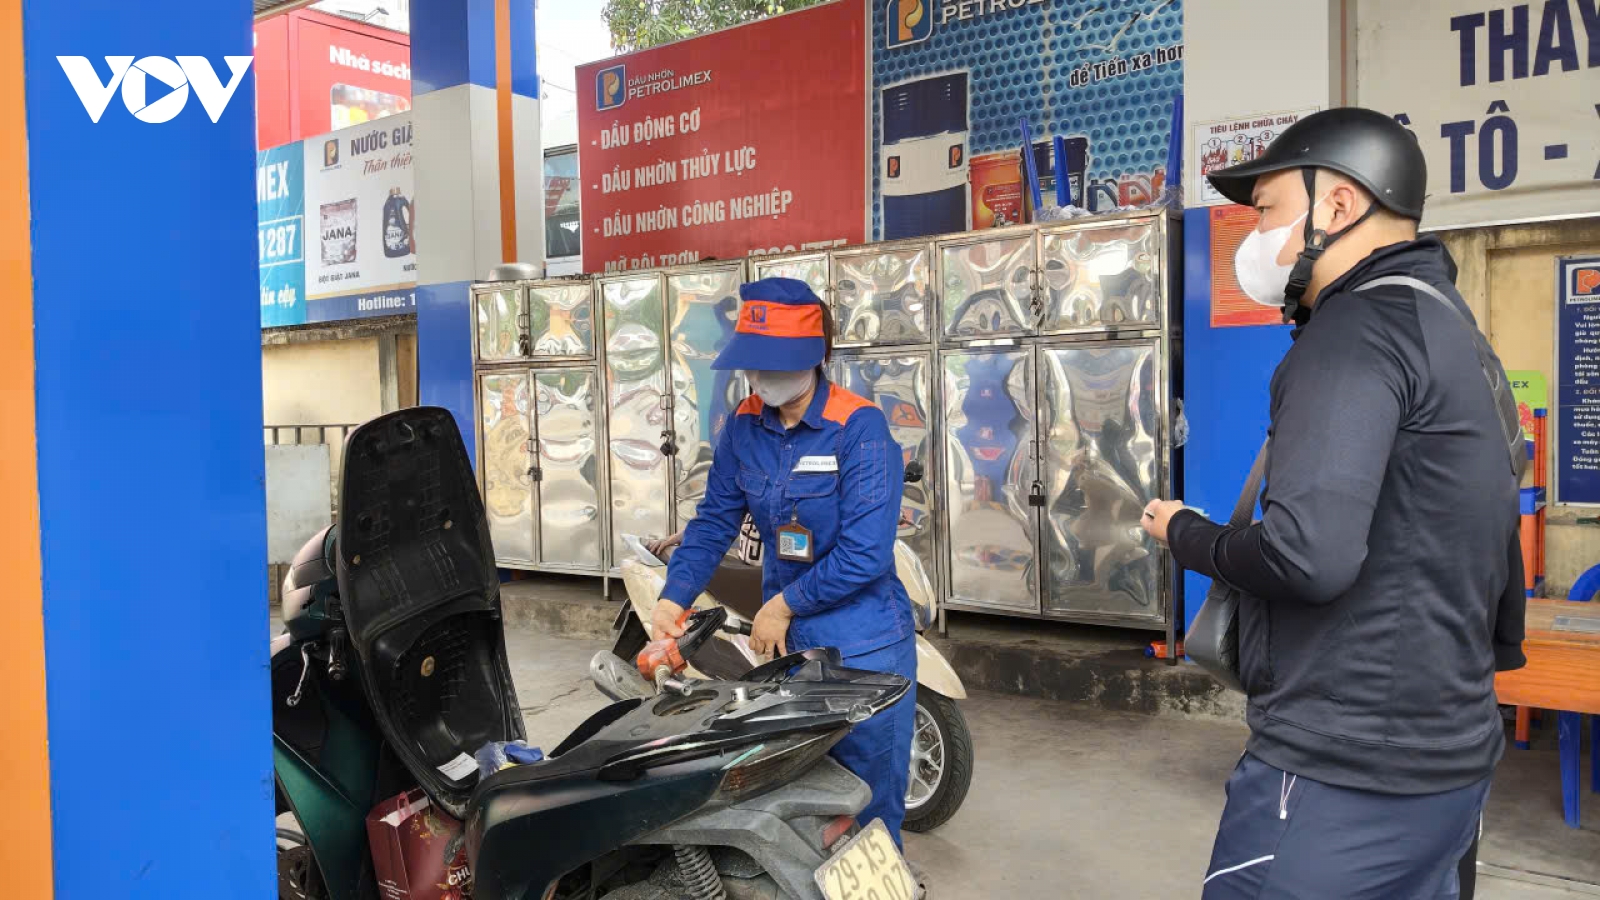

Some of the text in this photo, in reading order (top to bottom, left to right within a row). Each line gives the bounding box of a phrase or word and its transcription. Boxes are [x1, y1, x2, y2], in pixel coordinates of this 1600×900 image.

[330, 44, 370, 71] Nhà
[1093, 56, 1126, 80] Tiến
[1131, 54, 1151, 71] xa
[628, 70, 712, 100] PETROLIMEX
[351, 129, 387, 156] NƯỚC
[601, 120, 630, 150] DẦU
[634, 116, 675, 146] ĐỘNG
[679, 107, 701, 133] CƠ
[1441, 100, 1518, 193] TÔ
[602, 164, 631, 194] DẦU
[635, 159, 677, 187] NHỜN
[681, 148, 720, 179] THỦY
[725, 146, 756, 176] LỰC
[603, 210, 631, 237] DẦU
[635, 204, 677, 231] NHỜN
[682, 200, 725, 227] CÔNG
[730, 187, 793, 219] NGHIỆP
[323, 226, 353, 241] JANA
[358, 295, 406, 311] Hotline:
